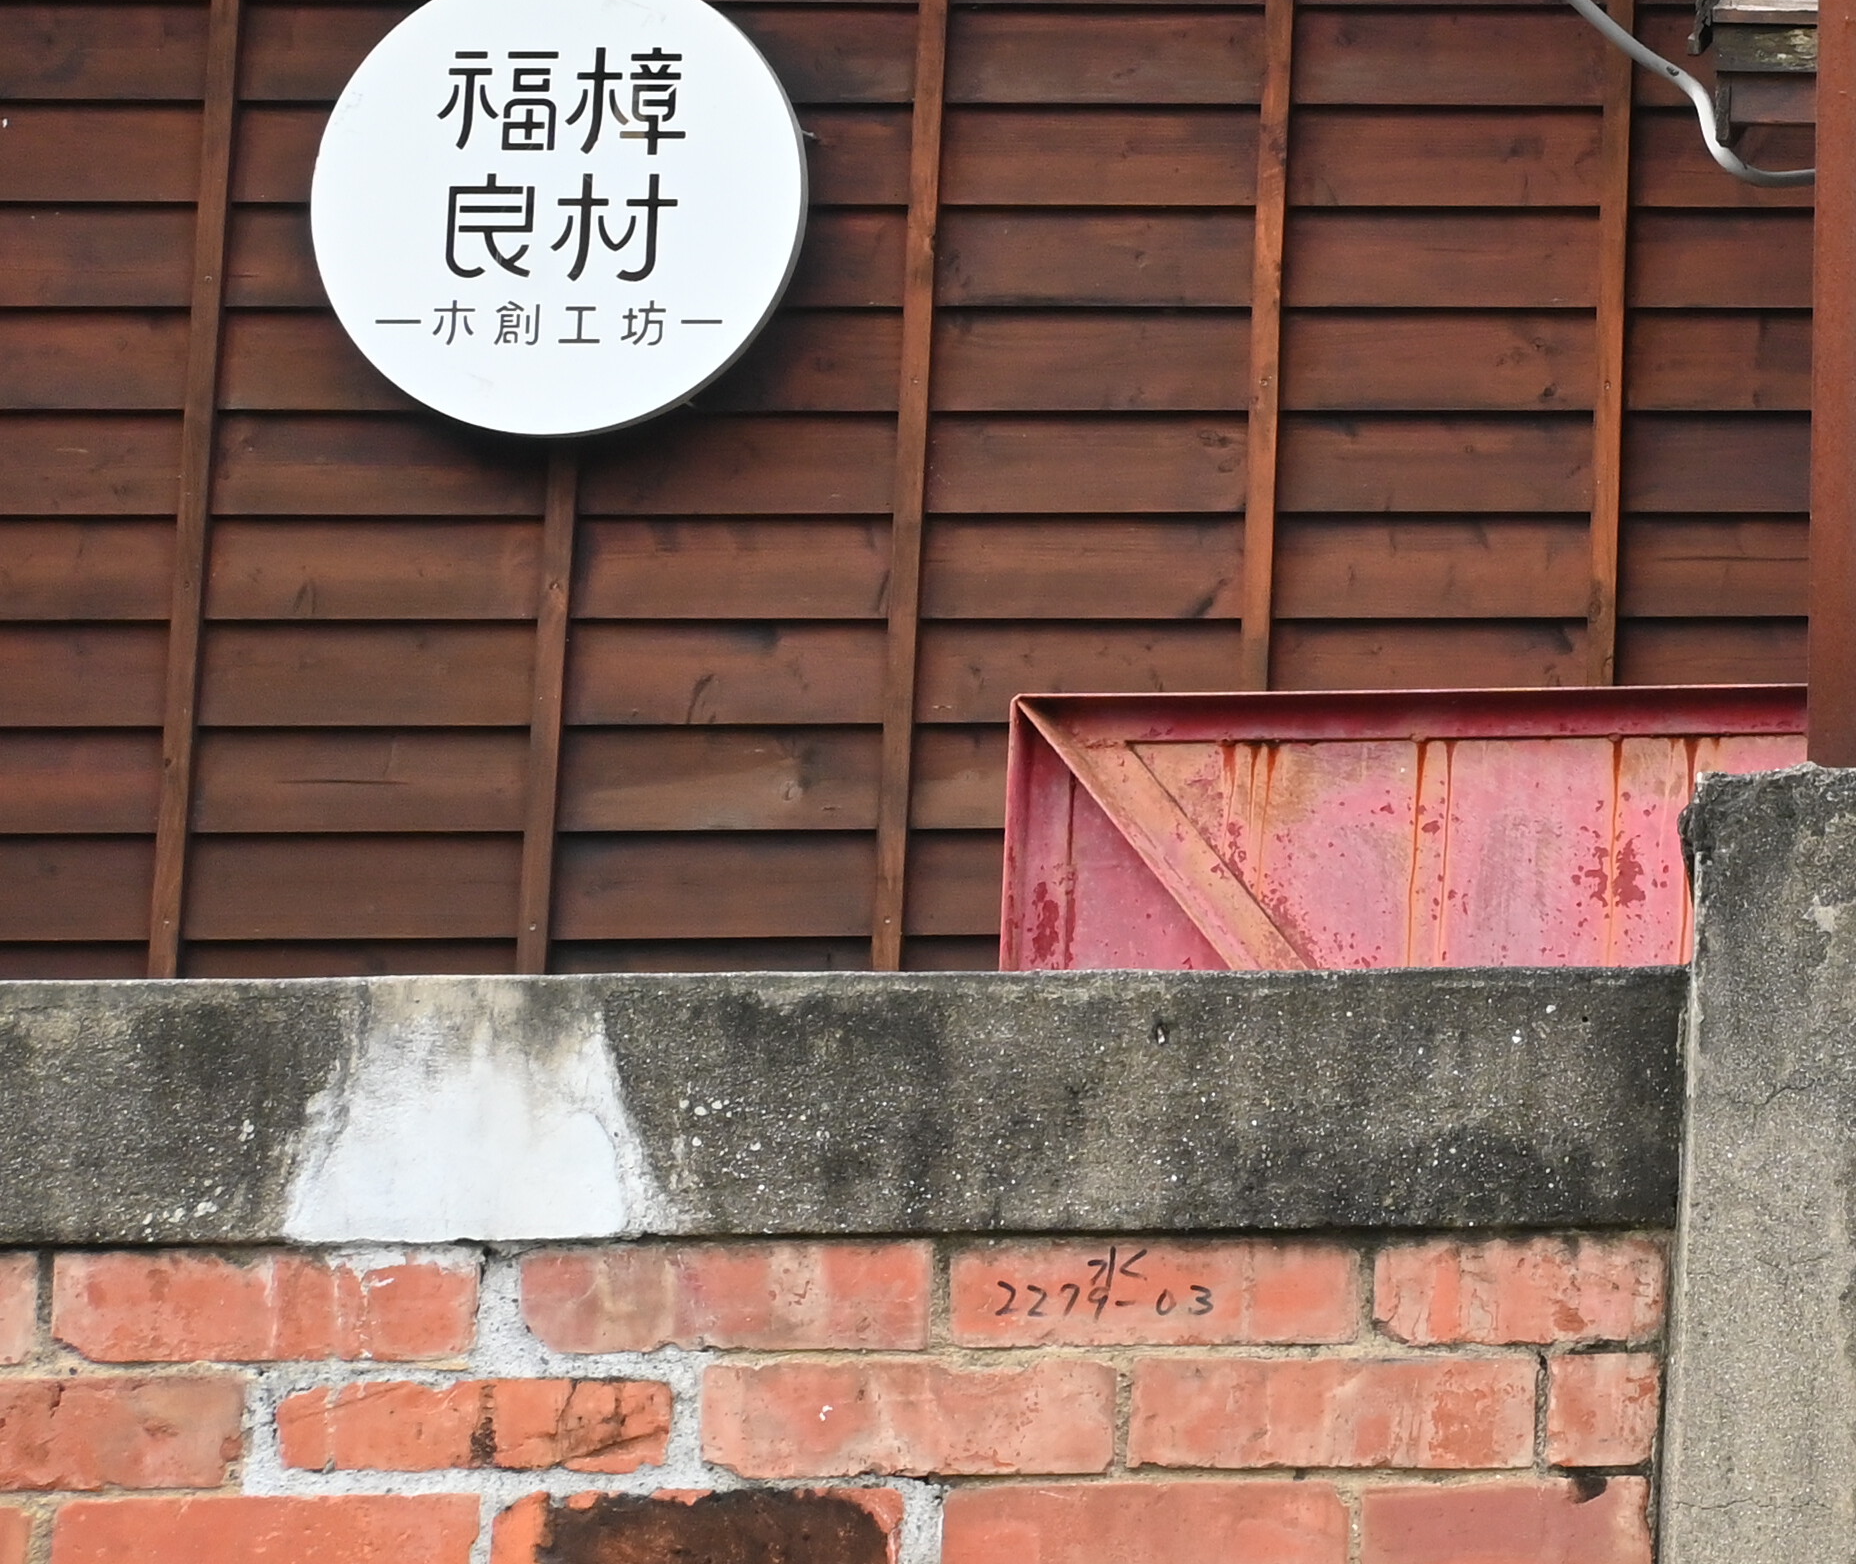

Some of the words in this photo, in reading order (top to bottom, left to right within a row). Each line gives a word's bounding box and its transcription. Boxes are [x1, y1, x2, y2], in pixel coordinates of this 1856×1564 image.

[437, 46, 687, 156] 福樟
[431, 298, 668, 348] 木創工坊
